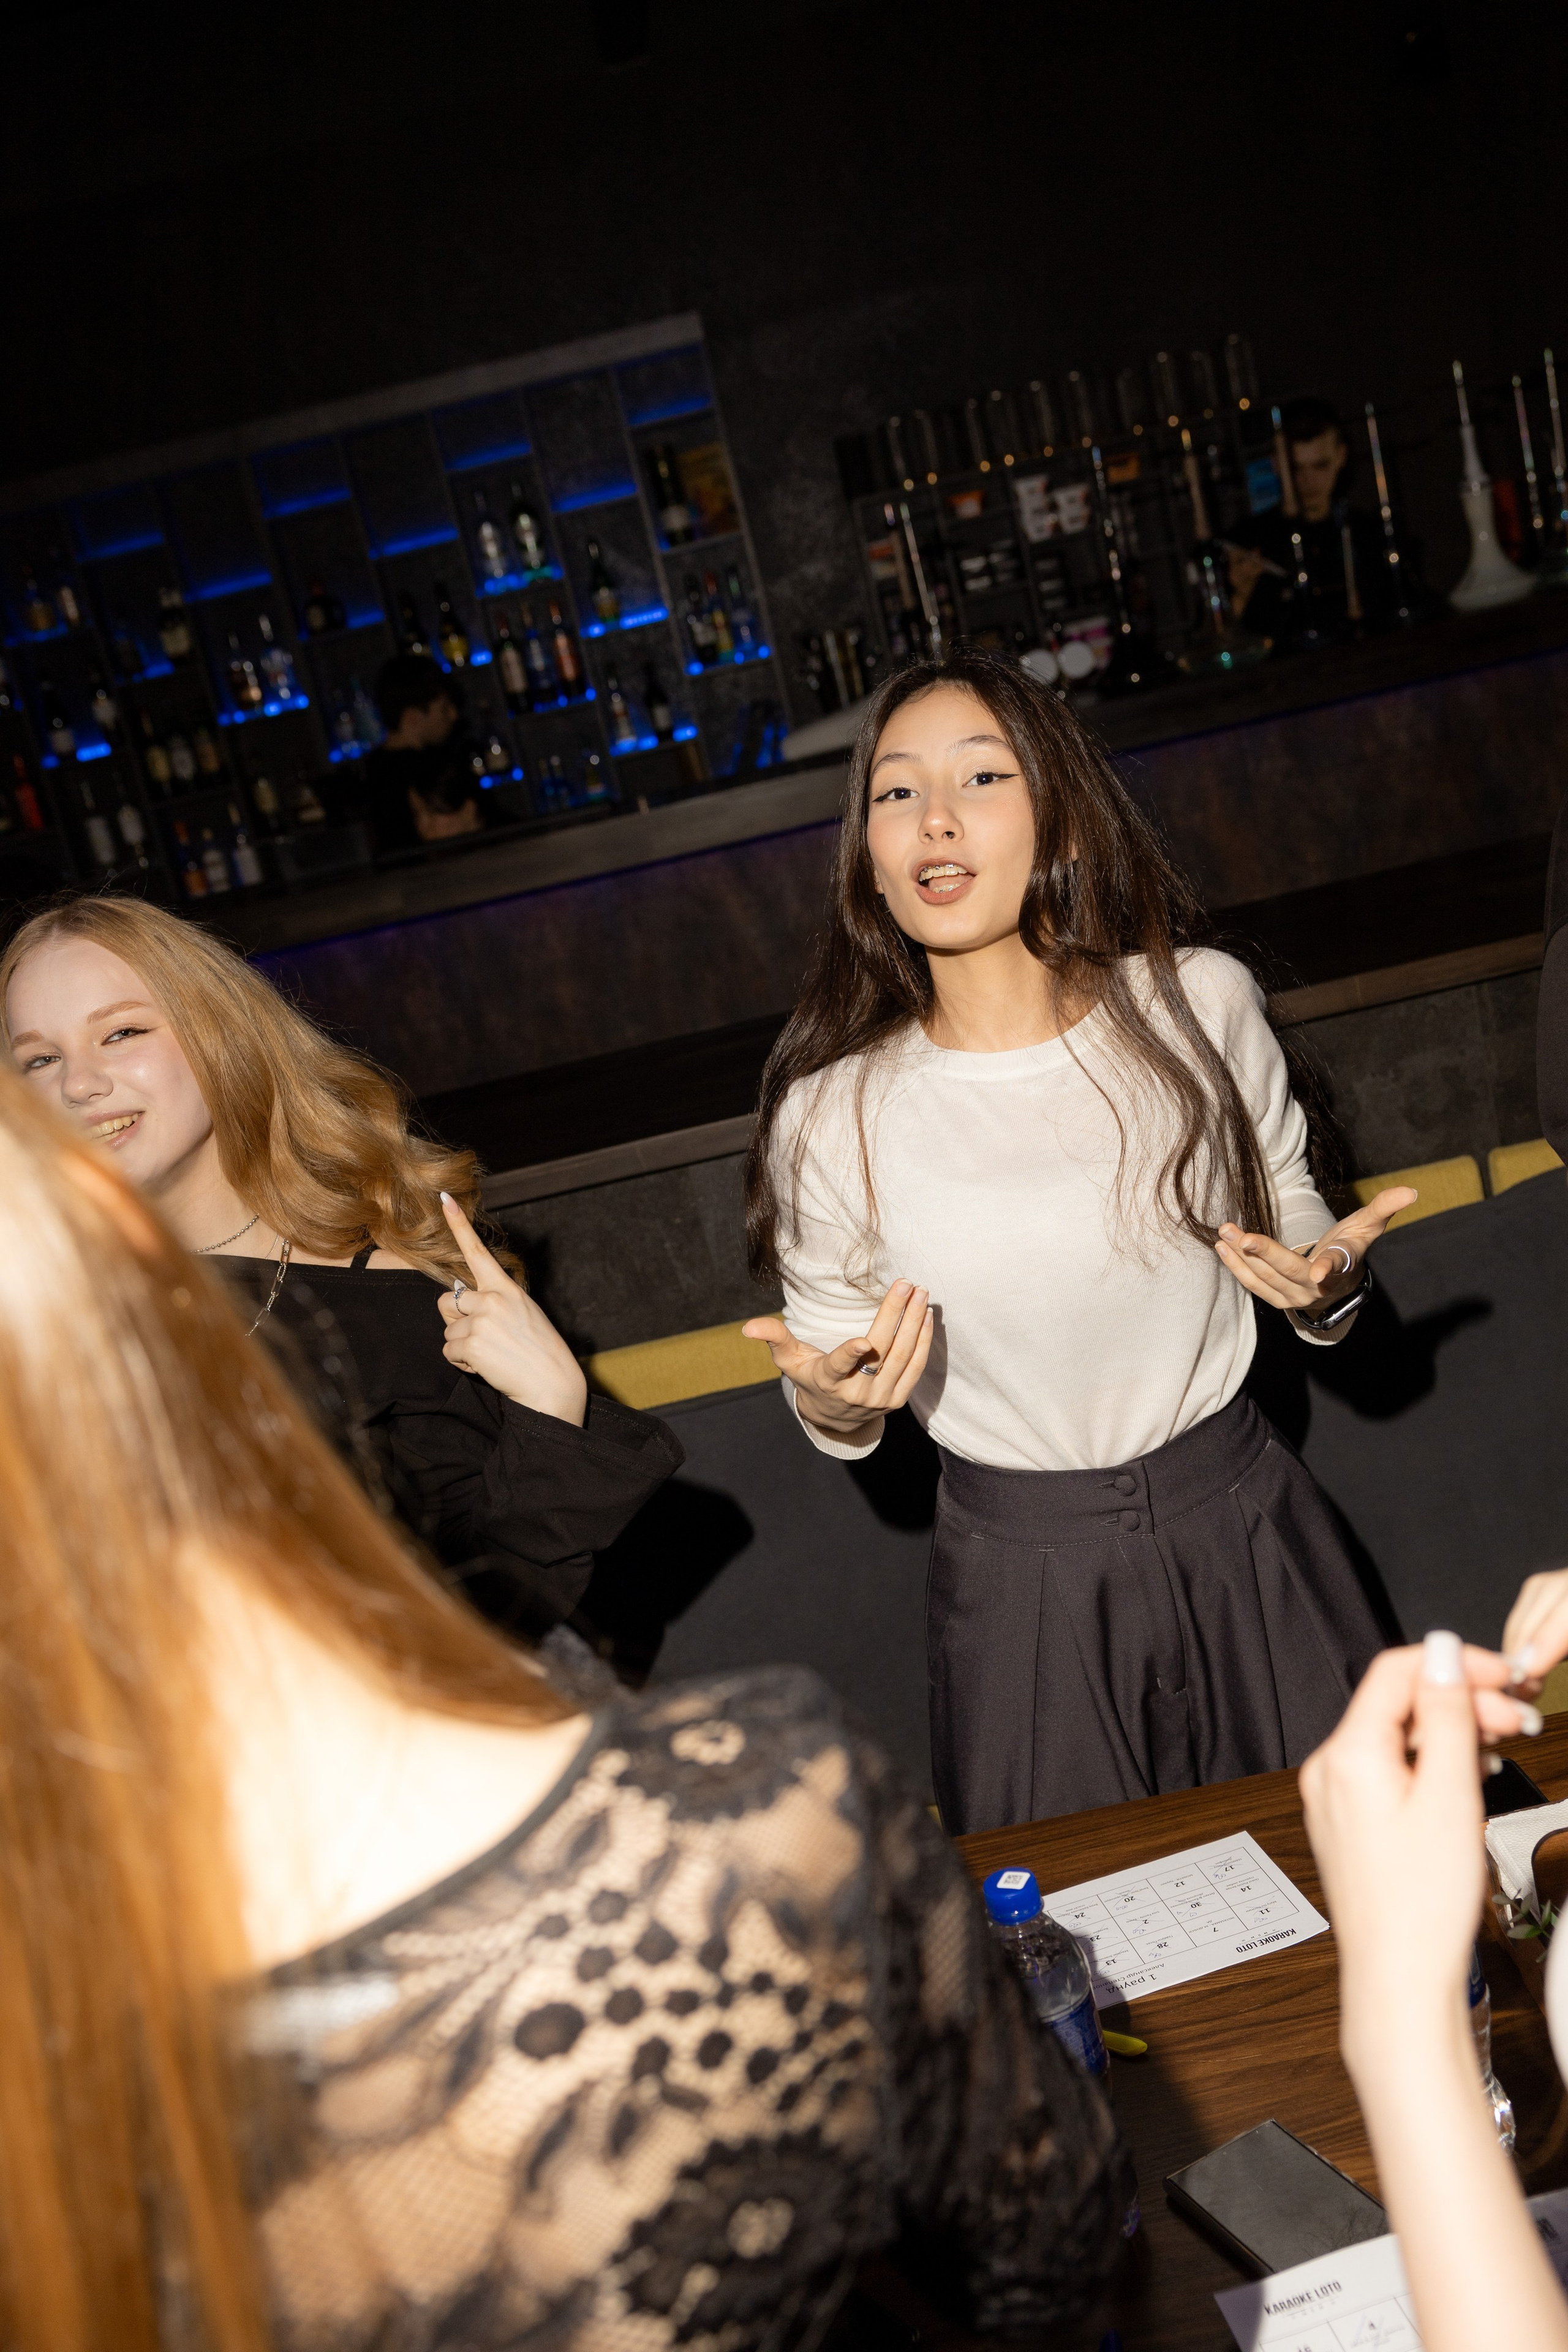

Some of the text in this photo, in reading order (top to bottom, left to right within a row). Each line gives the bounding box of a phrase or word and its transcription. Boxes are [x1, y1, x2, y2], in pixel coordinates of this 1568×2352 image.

[1211, 1917, 1235, 1926] INSTASAMKA
[1235, 1928, 1297, 1953] KARAOKE LOTO
[1125, 1962, 1165, 1979] Александр
[1105, 1976, 1145, 1994] раунд
[1264, 2280, 1342, 2315] KARAOKE LOTO
